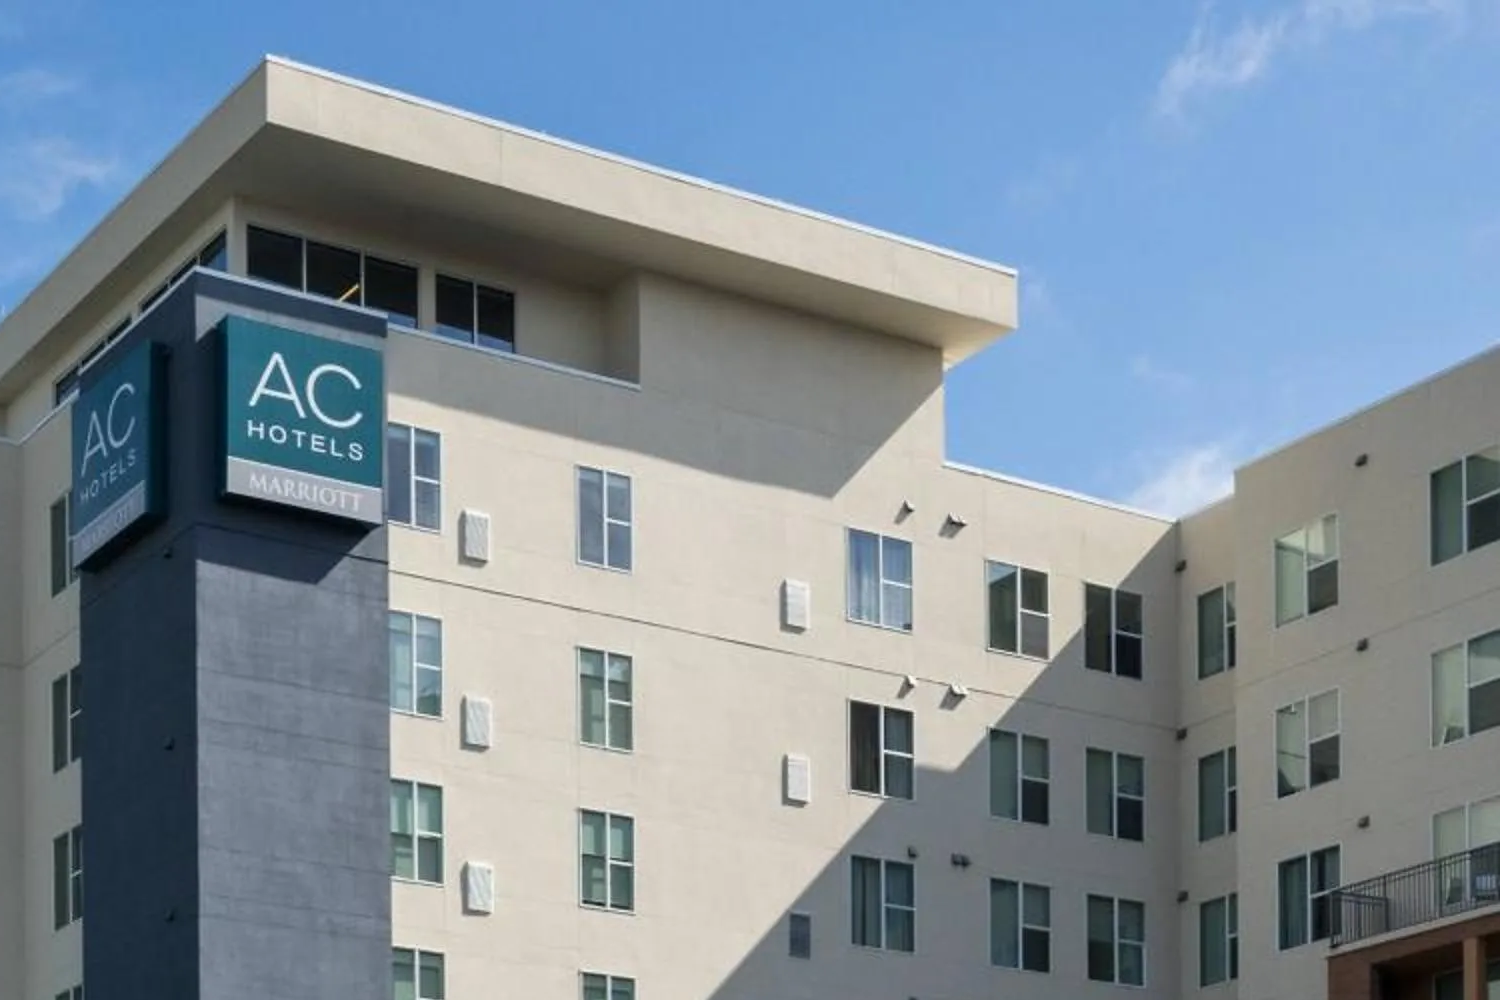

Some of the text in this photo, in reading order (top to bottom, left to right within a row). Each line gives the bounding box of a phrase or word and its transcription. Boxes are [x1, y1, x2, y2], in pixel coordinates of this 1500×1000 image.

[248, 352, 363, 429] AC
[80, 382, 136, 478] AC
[246, 419, 364, 461] HOTELS
[79, 448, 137, 504] HOTELS
[248, 470, 364, 513] MARRIOTT
